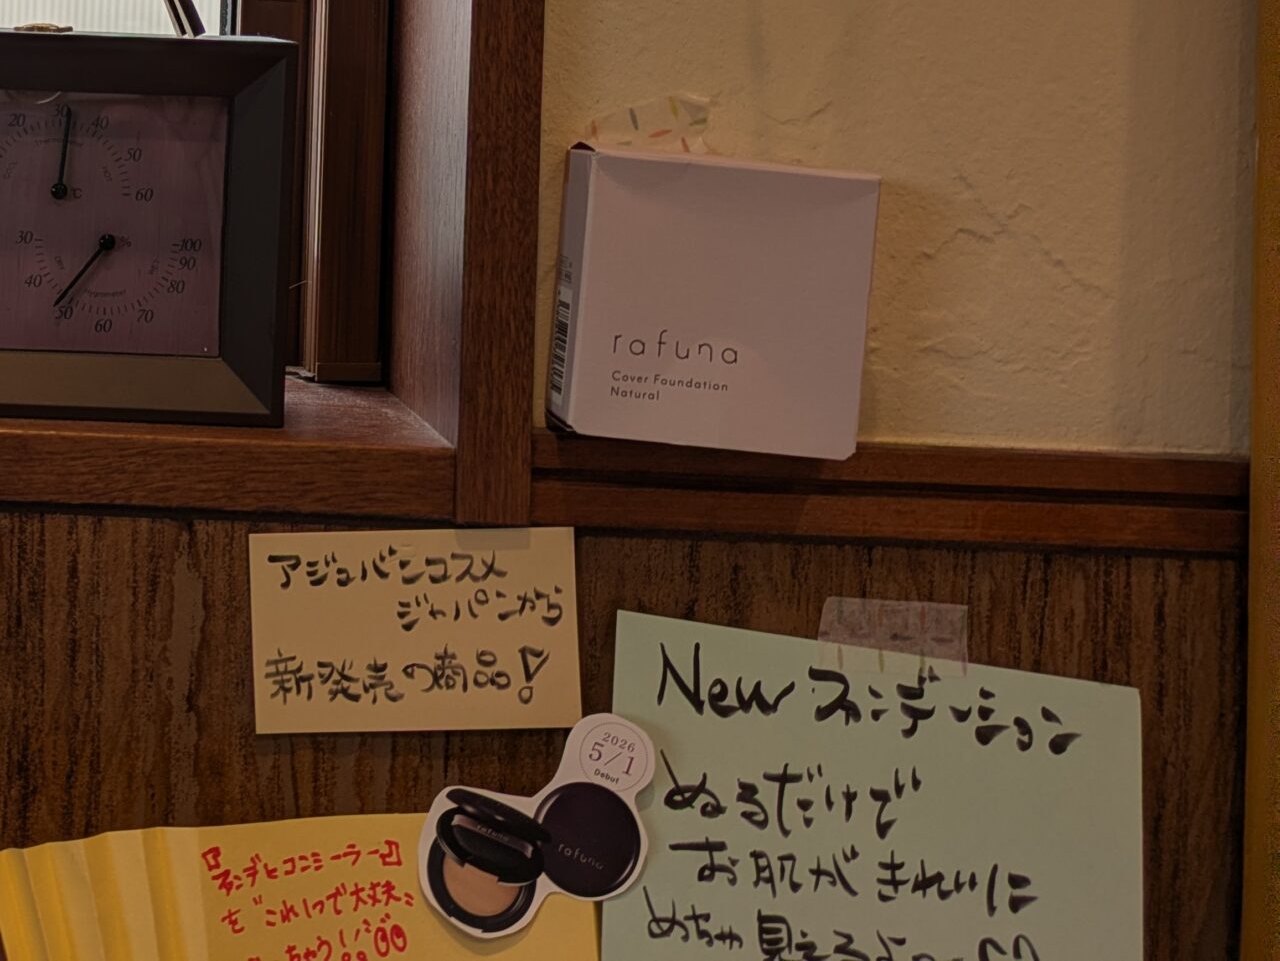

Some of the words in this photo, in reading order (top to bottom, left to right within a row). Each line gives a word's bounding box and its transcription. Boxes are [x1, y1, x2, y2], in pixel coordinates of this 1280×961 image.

[8, 113, 26, 127] 20
[91, 116, 109, 129] 40
[126, 148, 142, 161] 50
[135, 189, 154, 201] 60
[16, 231, 34, 244] 30
[178, 238, 202, 252] 100
[179, 257, 196, 271] 90
[24, 274, 42, 287] 40
[167, 280, 185, 294] 80
[137, 309, 154, 323] 70
[95, 319, 112, 333] 60
[612, 329, 738, 365] rafuna
[611, 370, 649, 384] Cover
[653, 374, 728, 391] Foundation
[610, 386, 660, 400] Natural
[396, 585, 564, 632] ジャパンから
[657, 641, 795, 718] New
[602, 731, 635, 753] 2026
[588, 741, 635, 777] 5/1
[594, 768, 620, 784] Debut
[659, 748, 922, 839] ぬるだけで
